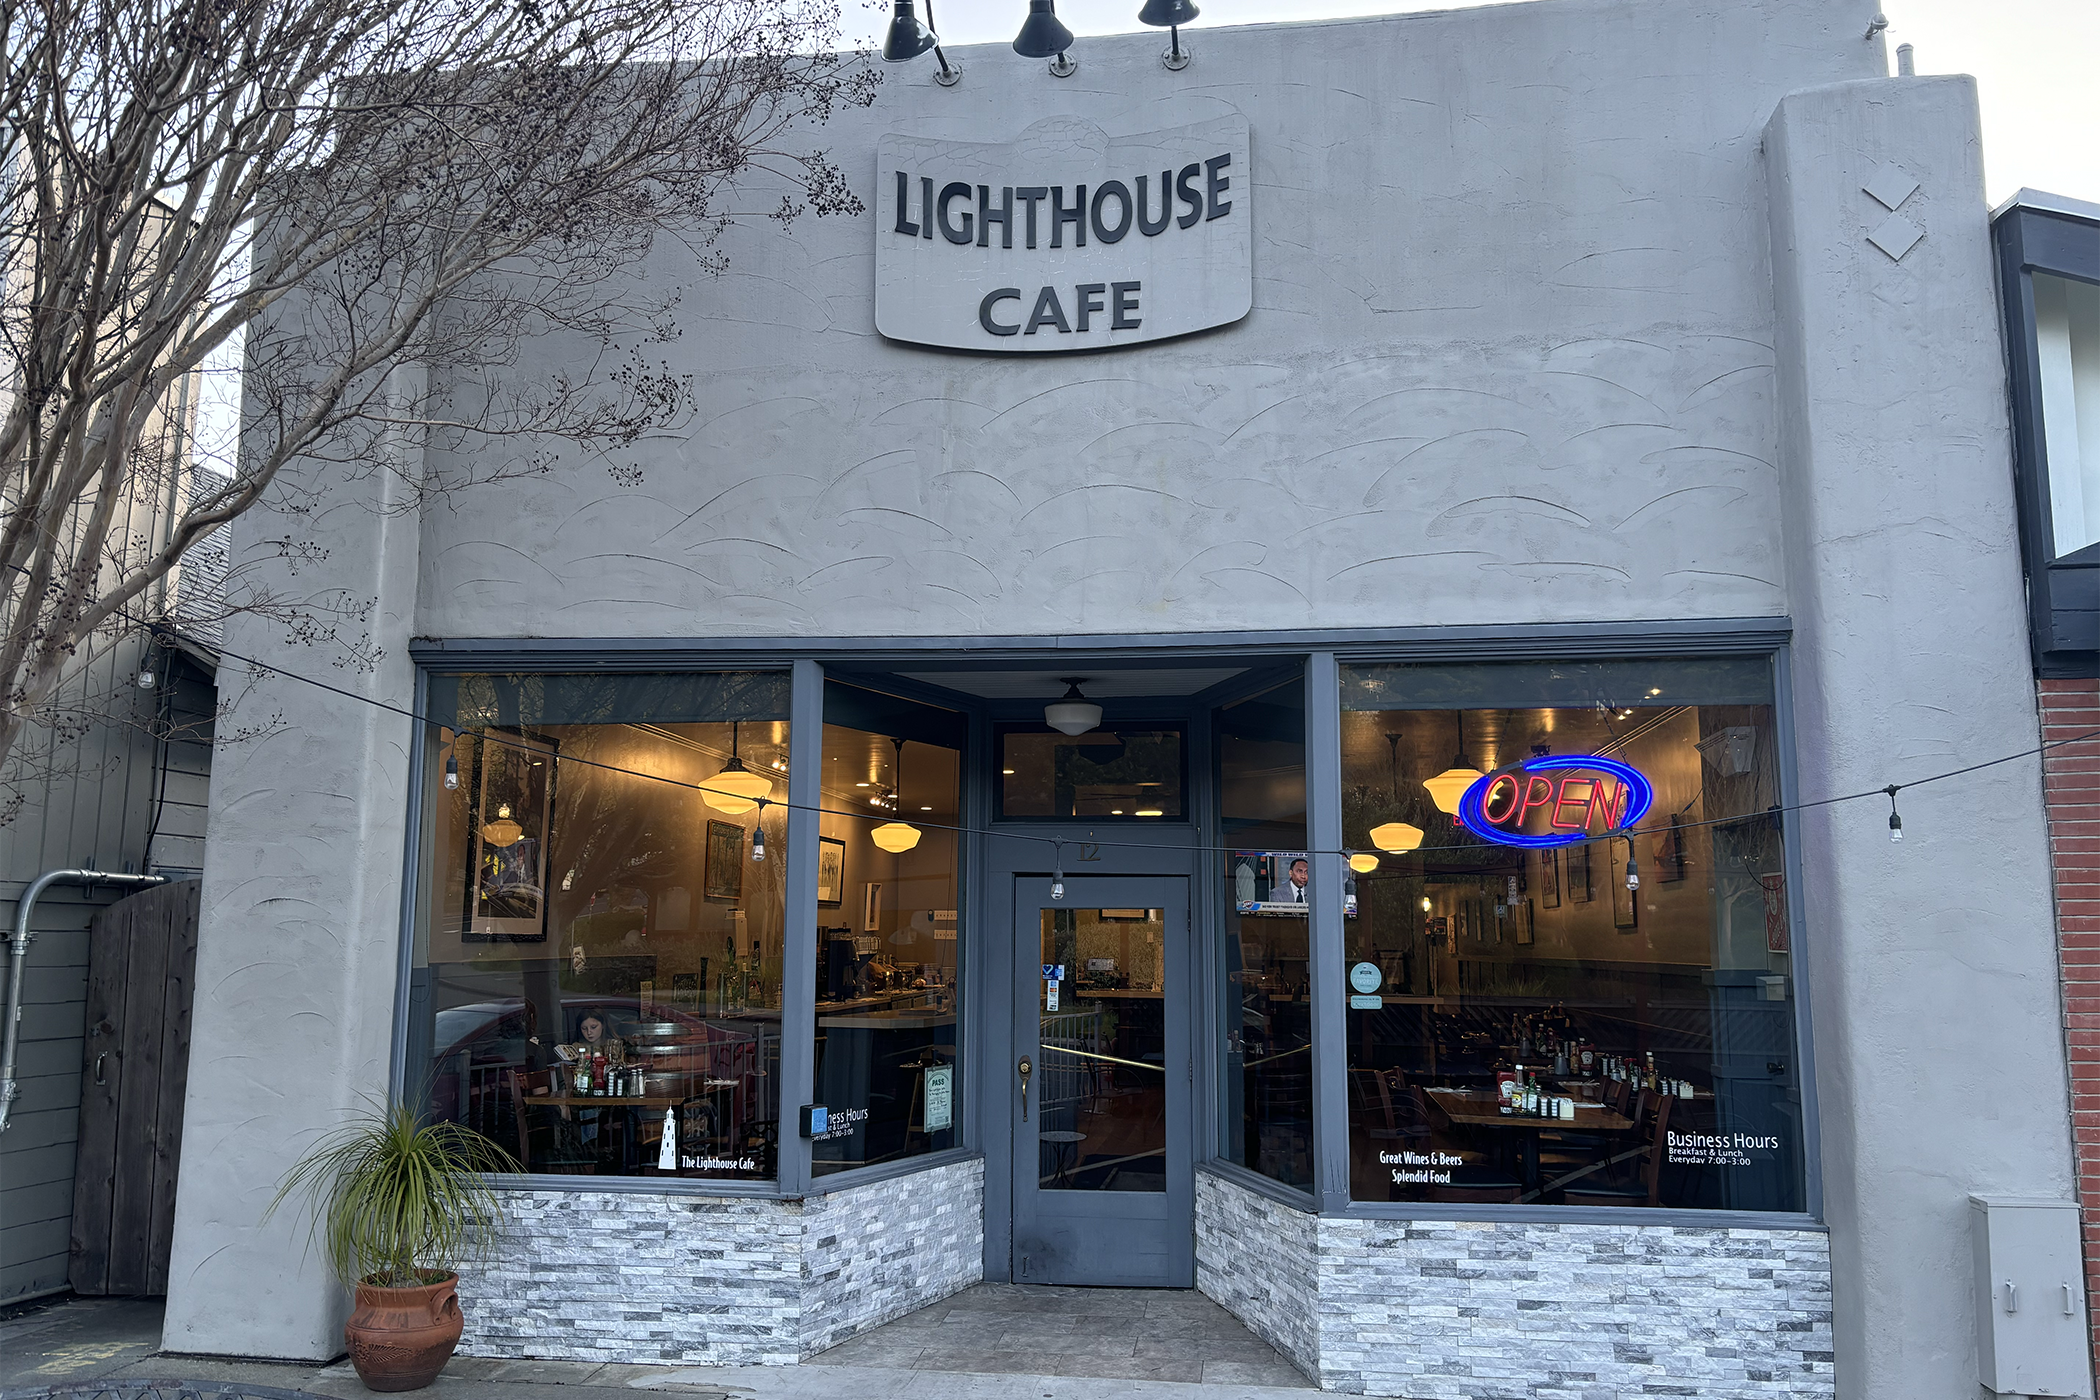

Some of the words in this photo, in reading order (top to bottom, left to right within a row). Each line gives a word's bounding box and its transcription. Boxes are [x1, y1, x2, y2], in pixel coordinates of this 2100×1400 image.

[895, 152, 1233, 250] LIGHTHOUSE
[979, 281, 1142, 337] CAFE
[1483, 774, 1622, 830] OPEN
[1077, 842, 1101, 861] 12
[932, 1078, 945, 1087] PASS
[827, 1112, 845, 1125] ness
[846, 1108, 869, 1122] Hours
[1667, 1130, 1730, 1148] Business
[1734, 1132, 1779, 1149] Hours
[1379, 1150, 1402, 1164] Great
[1403, 1151, 1429, 1165] Wines
[1431, 1152, 1438, 1165] &
[1439, 1152, 1462, 1166] Beers
[1668, 1147, 1707, 1156] Breakfast
[1709, 1148, 1716, 1156] &
[1717, 1149, 1743, 1157] Lunch
[1668, 1155, 1705, 1164] Everyday
[1708, 1156, 1751, 1166] 7:00-3:00
[682, 1155, 695, 1168] The
[696, 1155, 737, 1171] Lighthouse
[739, 1156, 755, 1170] Cafe
[1391, 1168, 1428, 1185] Splendid
[1430, 1170, 1451, 1183] Food
